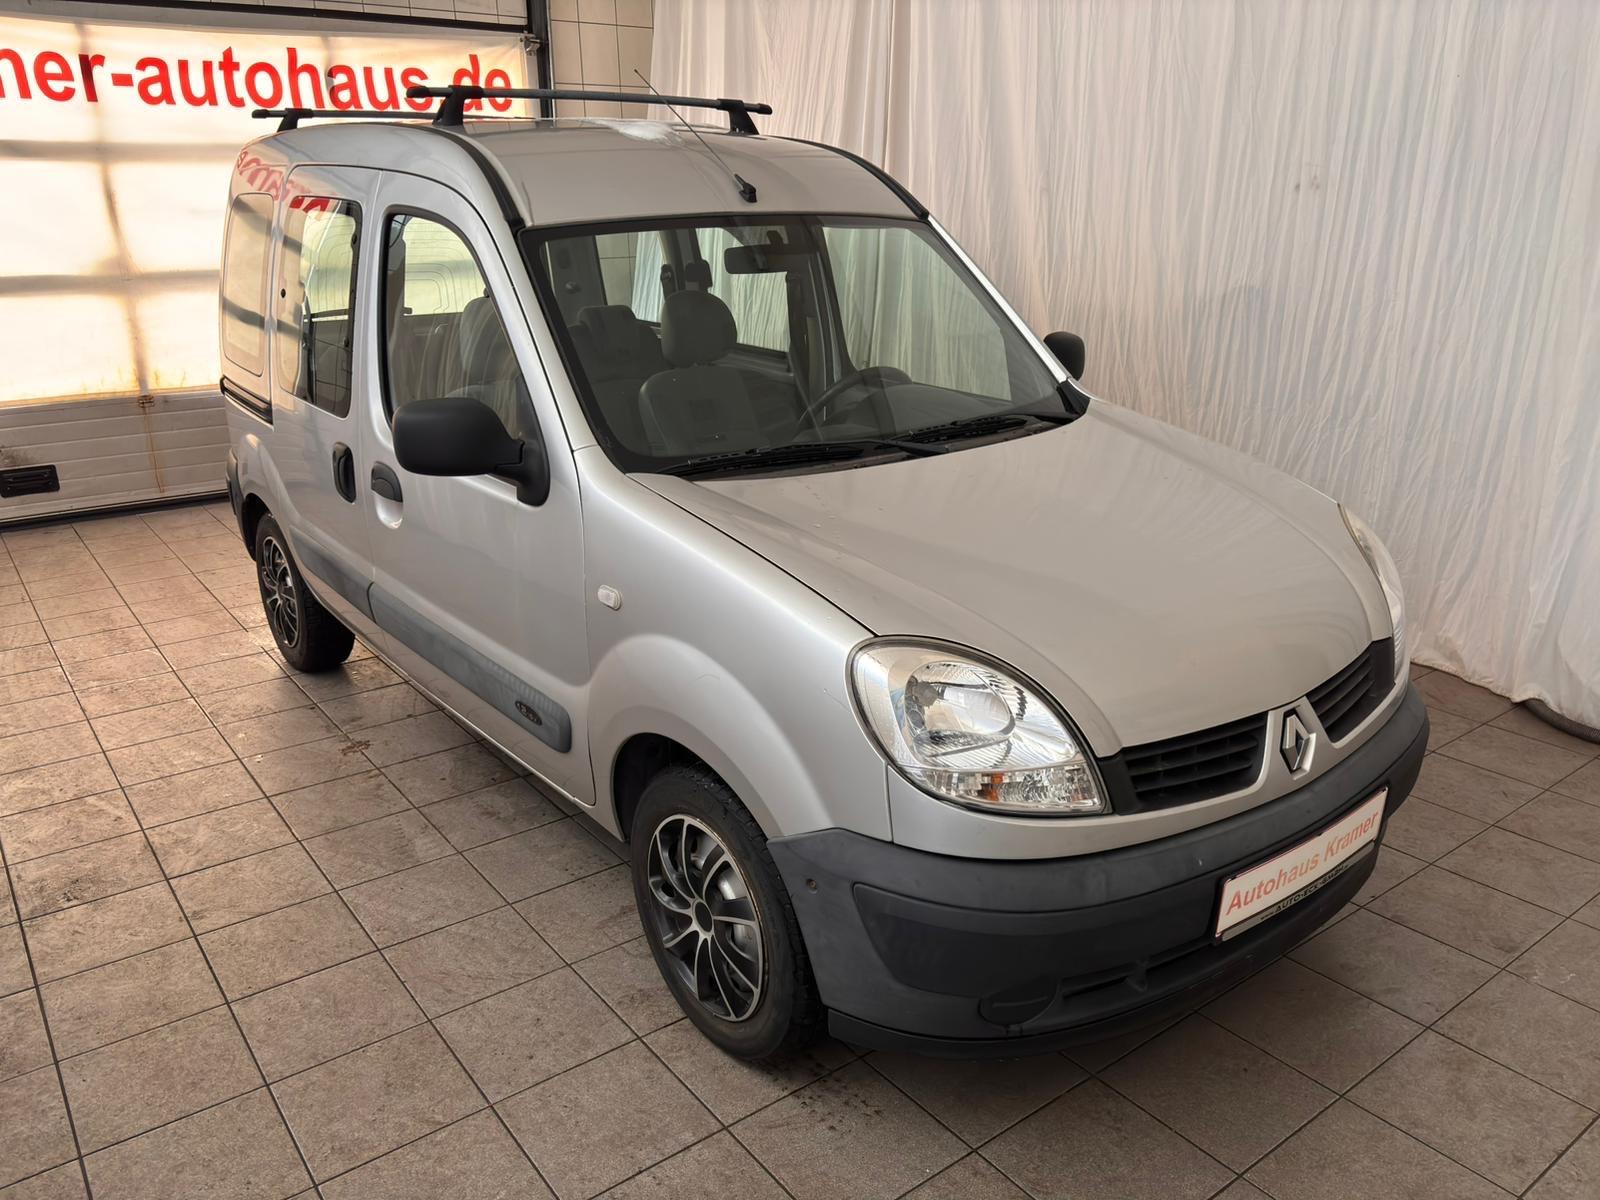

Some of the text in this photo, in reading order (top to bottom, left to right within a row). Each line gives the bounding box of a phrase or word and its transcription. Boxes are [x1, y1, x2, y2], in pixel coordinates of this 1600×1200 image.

[0, 46, 513, 112] er-autohausde
[1226, 811, 1379, 915] Autohaus Kramer
